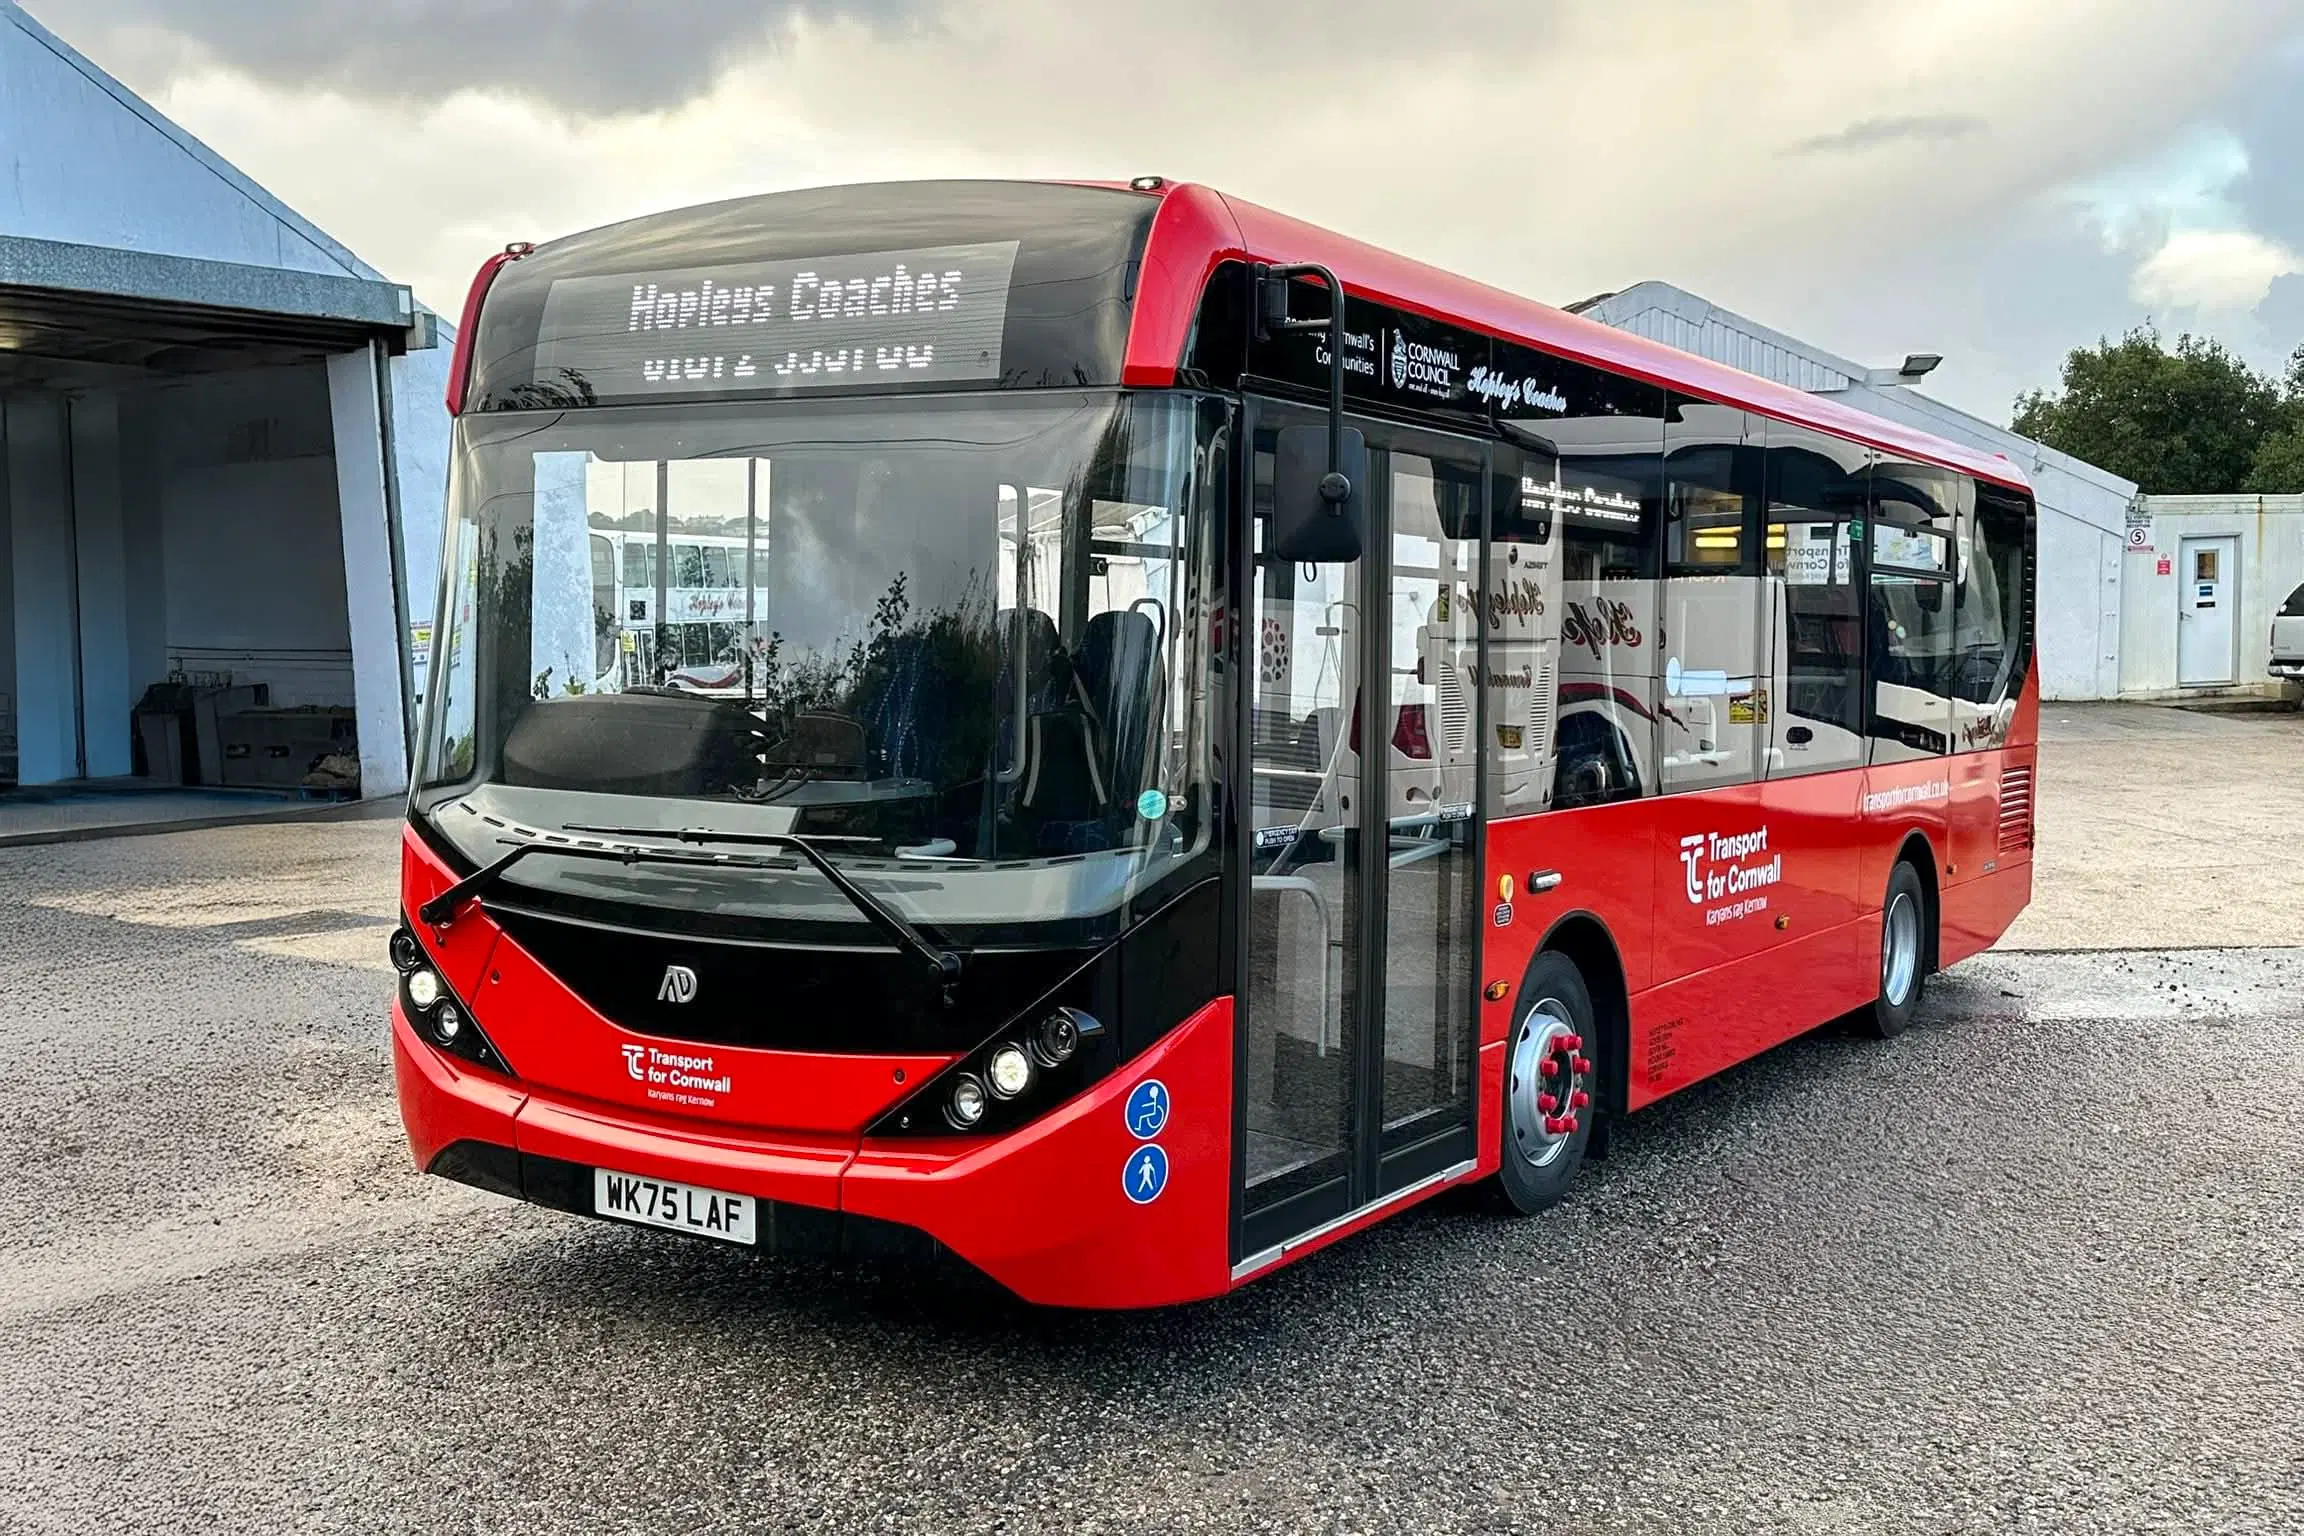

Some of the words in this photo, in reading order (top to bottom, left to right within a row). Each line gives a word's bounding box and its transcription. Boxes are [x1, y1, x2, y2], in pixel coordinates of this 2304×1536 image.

[629, 280, 775, 332] Hopleys
[790, 264, 962, 321] Coaches
[1315, 346, 1375, 376] Counities
[1408, 343, 1460, 370] CORNWALL
[1408, 361, 1451, 386] COUNCIL
[1708, 824, 1768, 862] Transport
[1707, 869, 1727, 899] for
[1727, 853, 1781, 894] Cornwall
[648, 1047, 713, 1072] Transport
[648, 1066, 667, 1083] for
[670, 1069, 731, 1093] Cornwall
[607, 1175, 678, 1221] WK75
[687, 1190, 742, 1233] LAF
